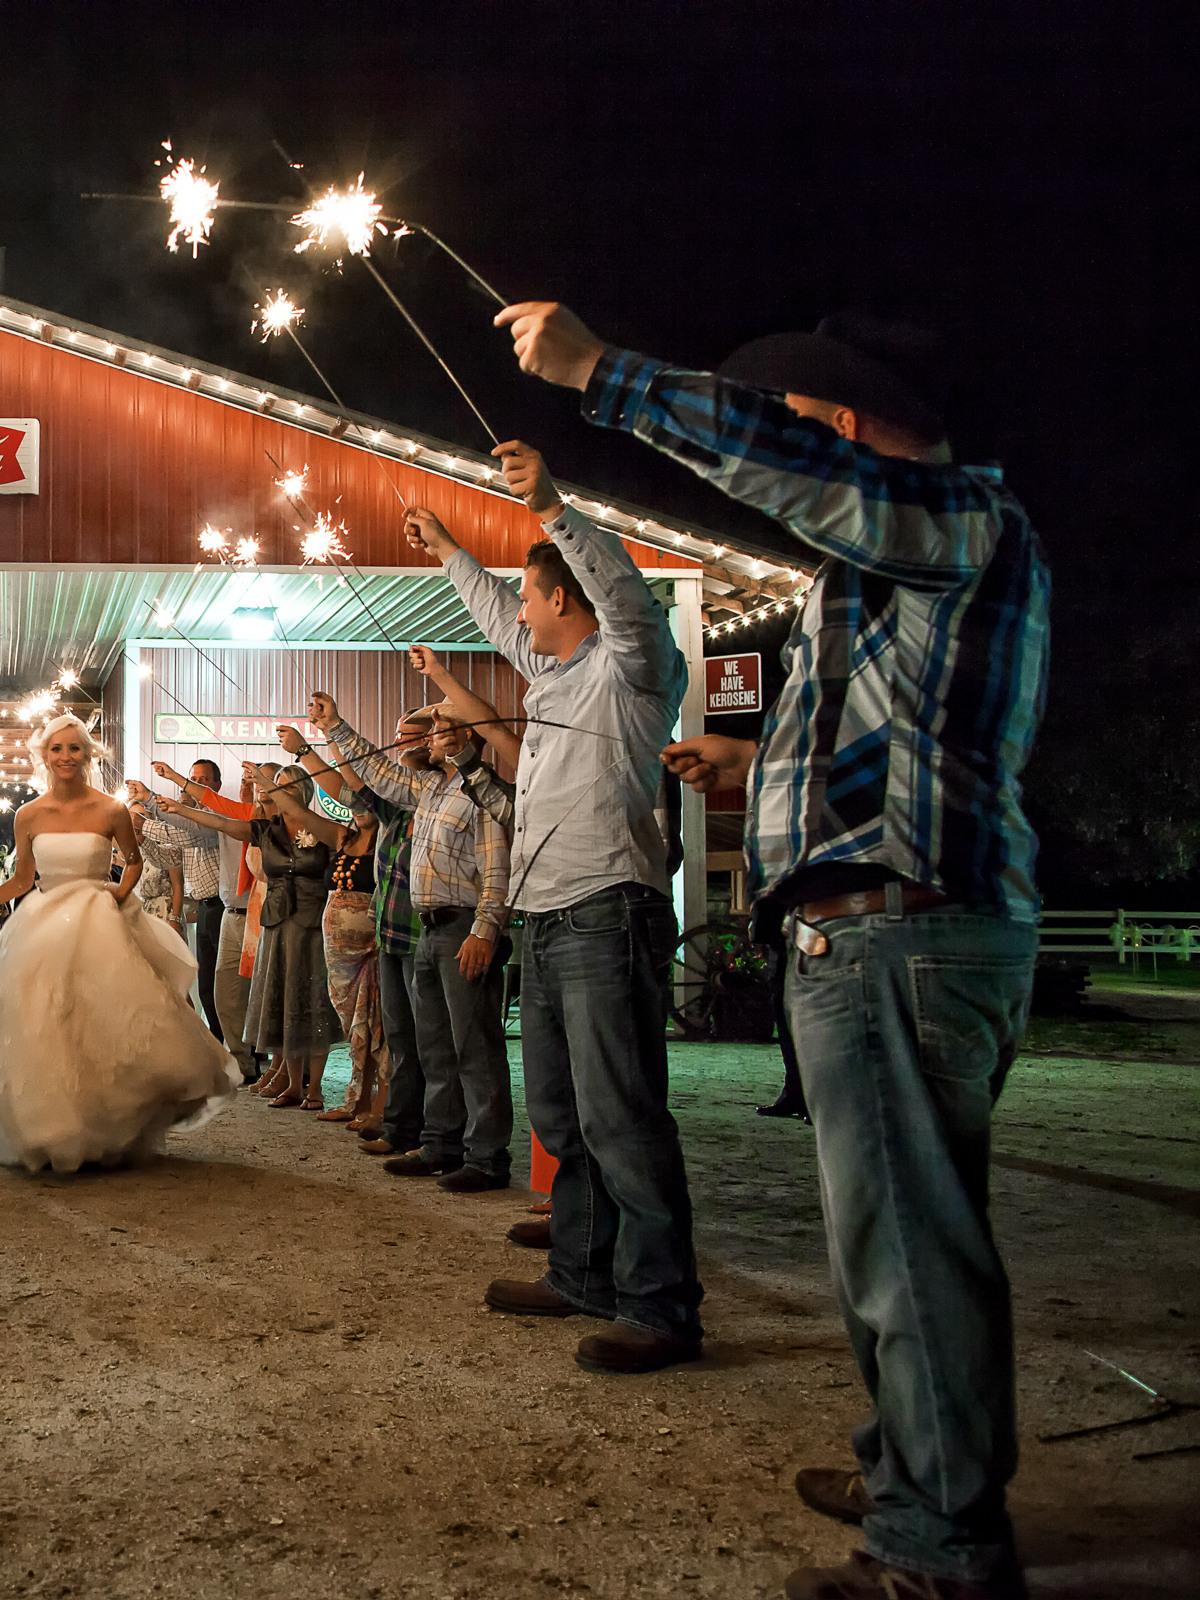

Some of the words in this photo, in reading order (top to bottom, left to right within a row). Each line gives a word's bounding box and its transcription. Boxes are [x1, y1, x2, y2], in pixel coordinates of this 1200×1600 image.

[724, 660, 739, 675] WE
[720, 676, 744, 691] HAVE
[709, 690, 756, 708] KEROSENE
